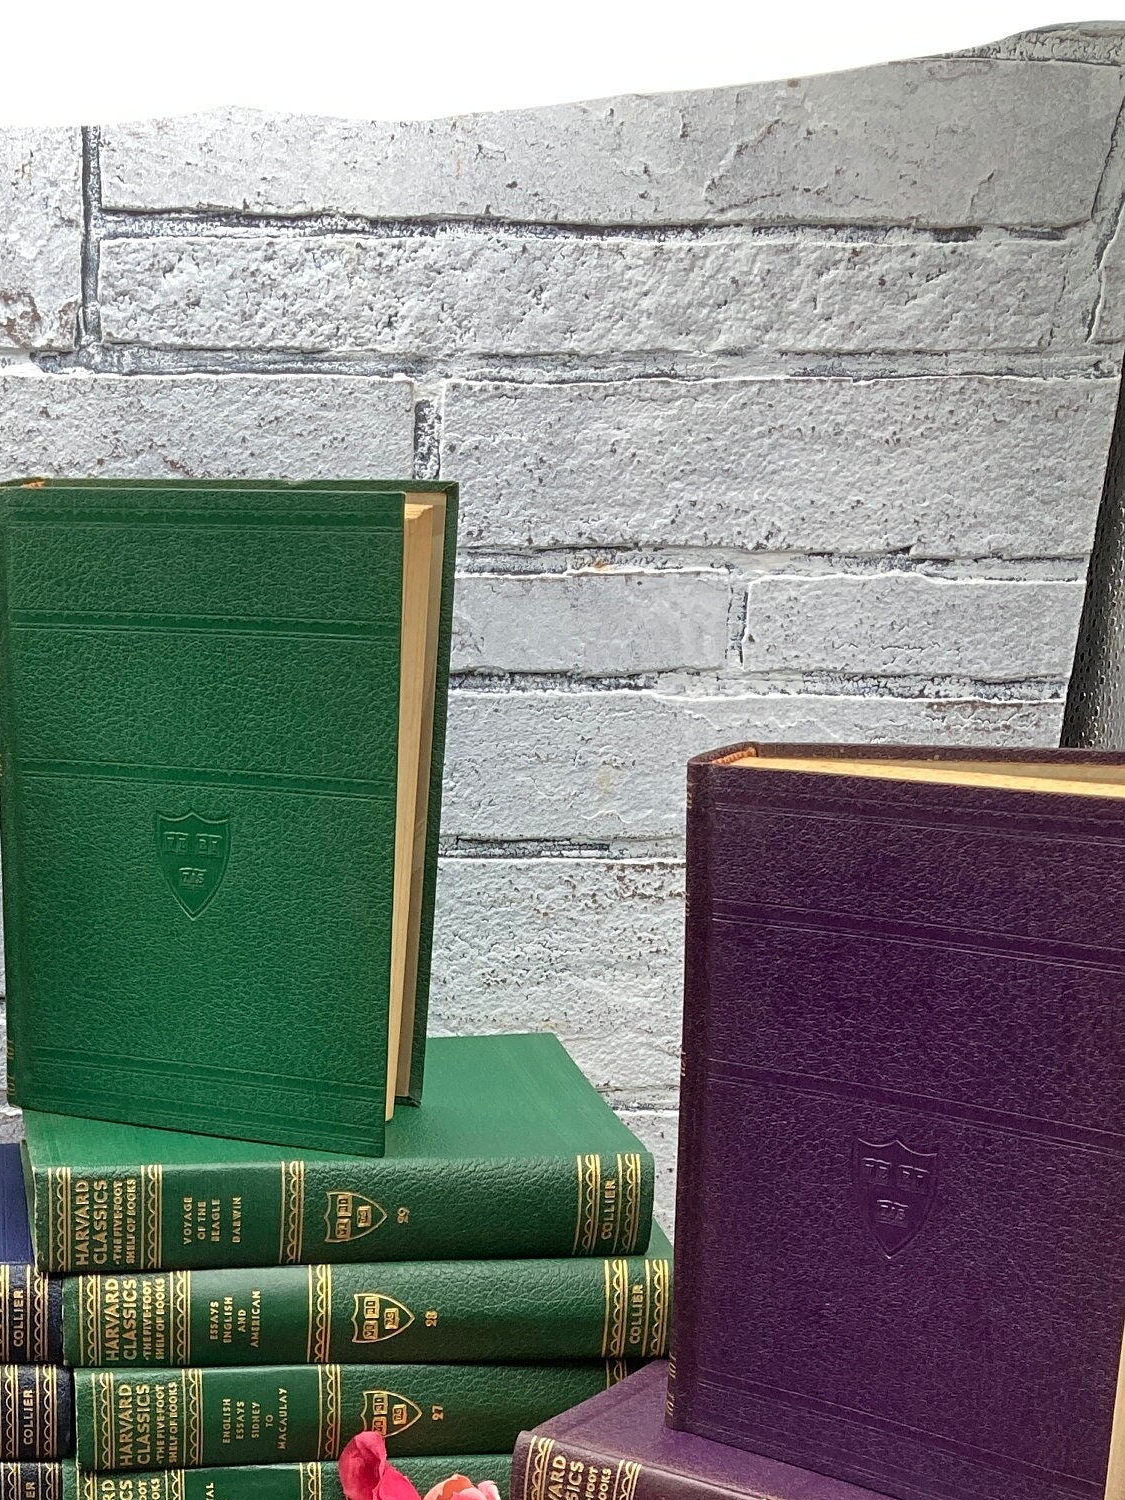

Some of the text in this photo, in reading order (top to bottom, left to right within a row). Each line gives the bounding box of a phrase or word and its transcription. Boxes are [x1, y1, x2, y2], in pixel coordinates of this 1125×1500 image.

[75, 1180, 90, 1265] HARVARD
[93, 1180, 108, 1264] CLASSICS
[601, 1180, 616, 1240] COLLIER
[13, 1290, 24, 1347] COLLIER
[105, 1279, 120, 1361] HARVARD
[123, 1279, 137, 1360] CLASSICS
[251, 1290, 261, 1347] AMERICAN
[629, 1285, 643, 1344] COLLIER
[23, 1389, 32, 1445] COLLIER
[119, 1384, 135, 1467] HARVARD
[137, 1384, 151, 1464] CLASSICS
[278, 1388, 288, 1449] MACAULAY
